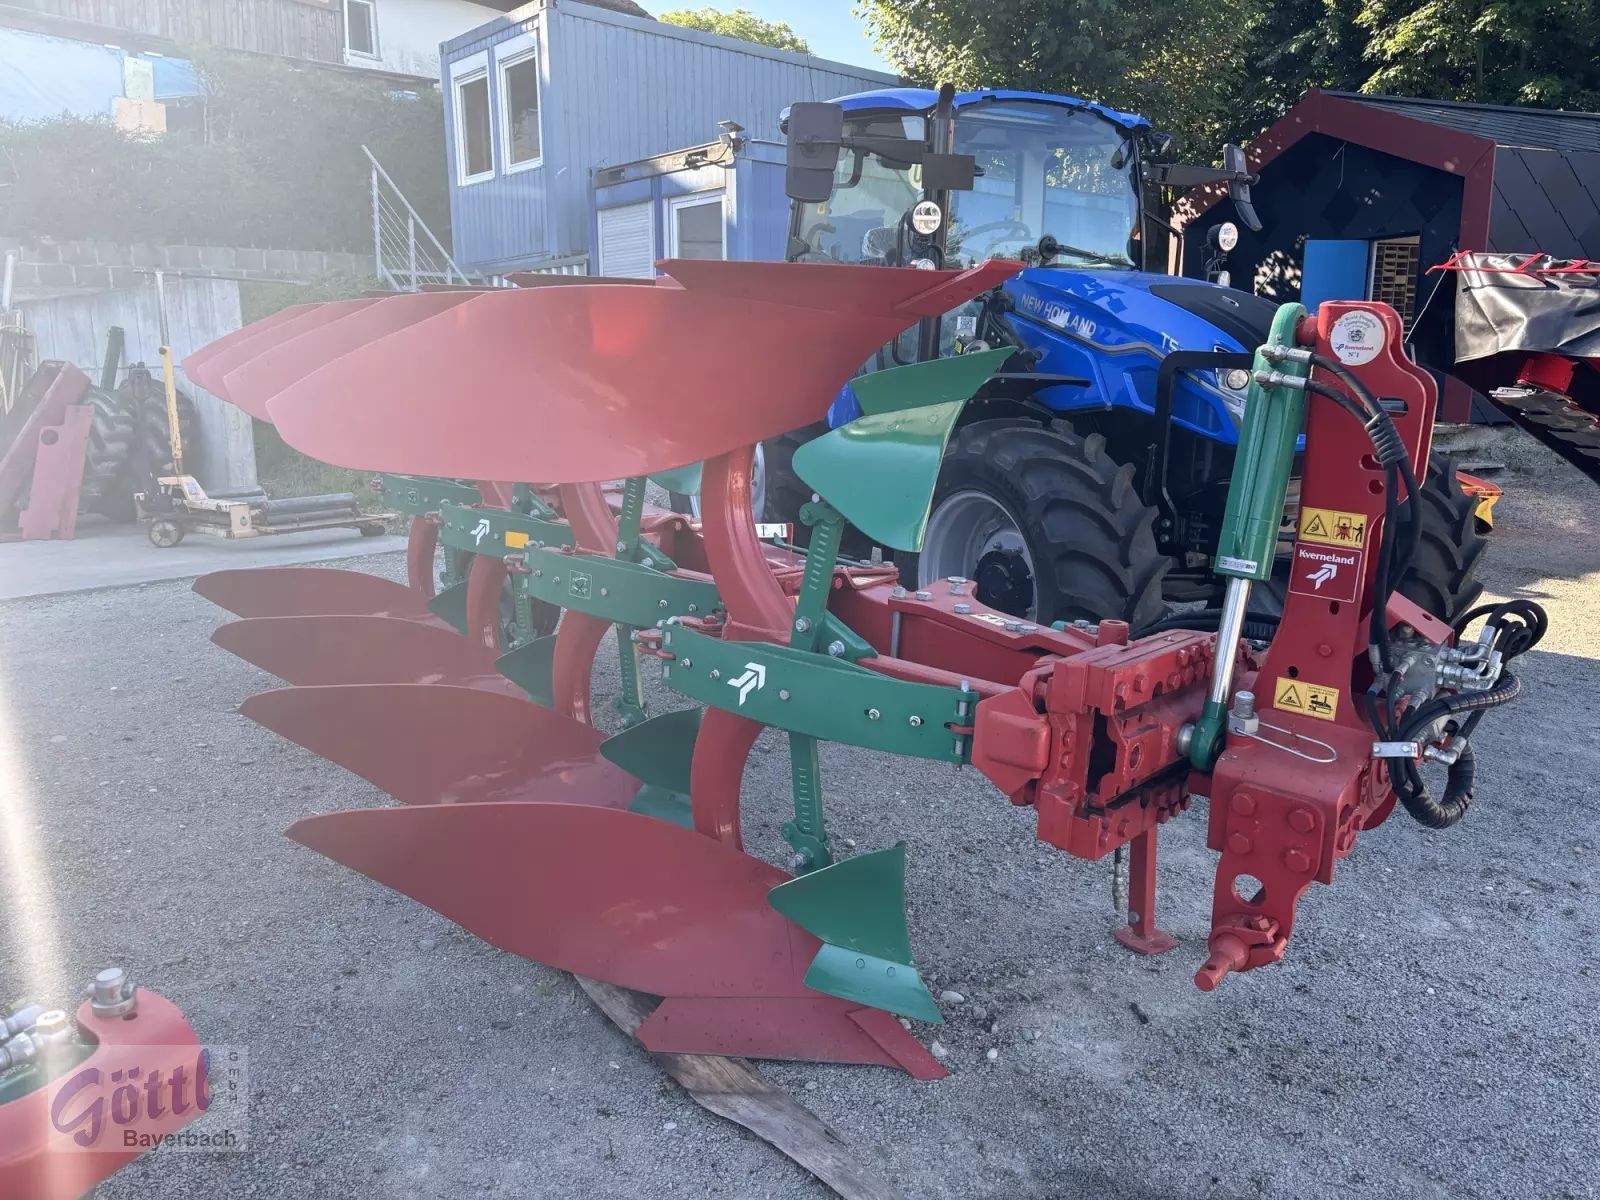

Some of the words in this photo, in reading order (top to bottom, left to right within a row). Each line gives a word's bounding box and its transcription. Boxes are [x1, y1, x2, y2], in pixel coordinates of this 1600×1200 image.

[1021, 294, 1044, 313] NEW
[1044, 303, 1097, 337] HOLLAND
[1299, 549, 1355, 565] Kverneland
